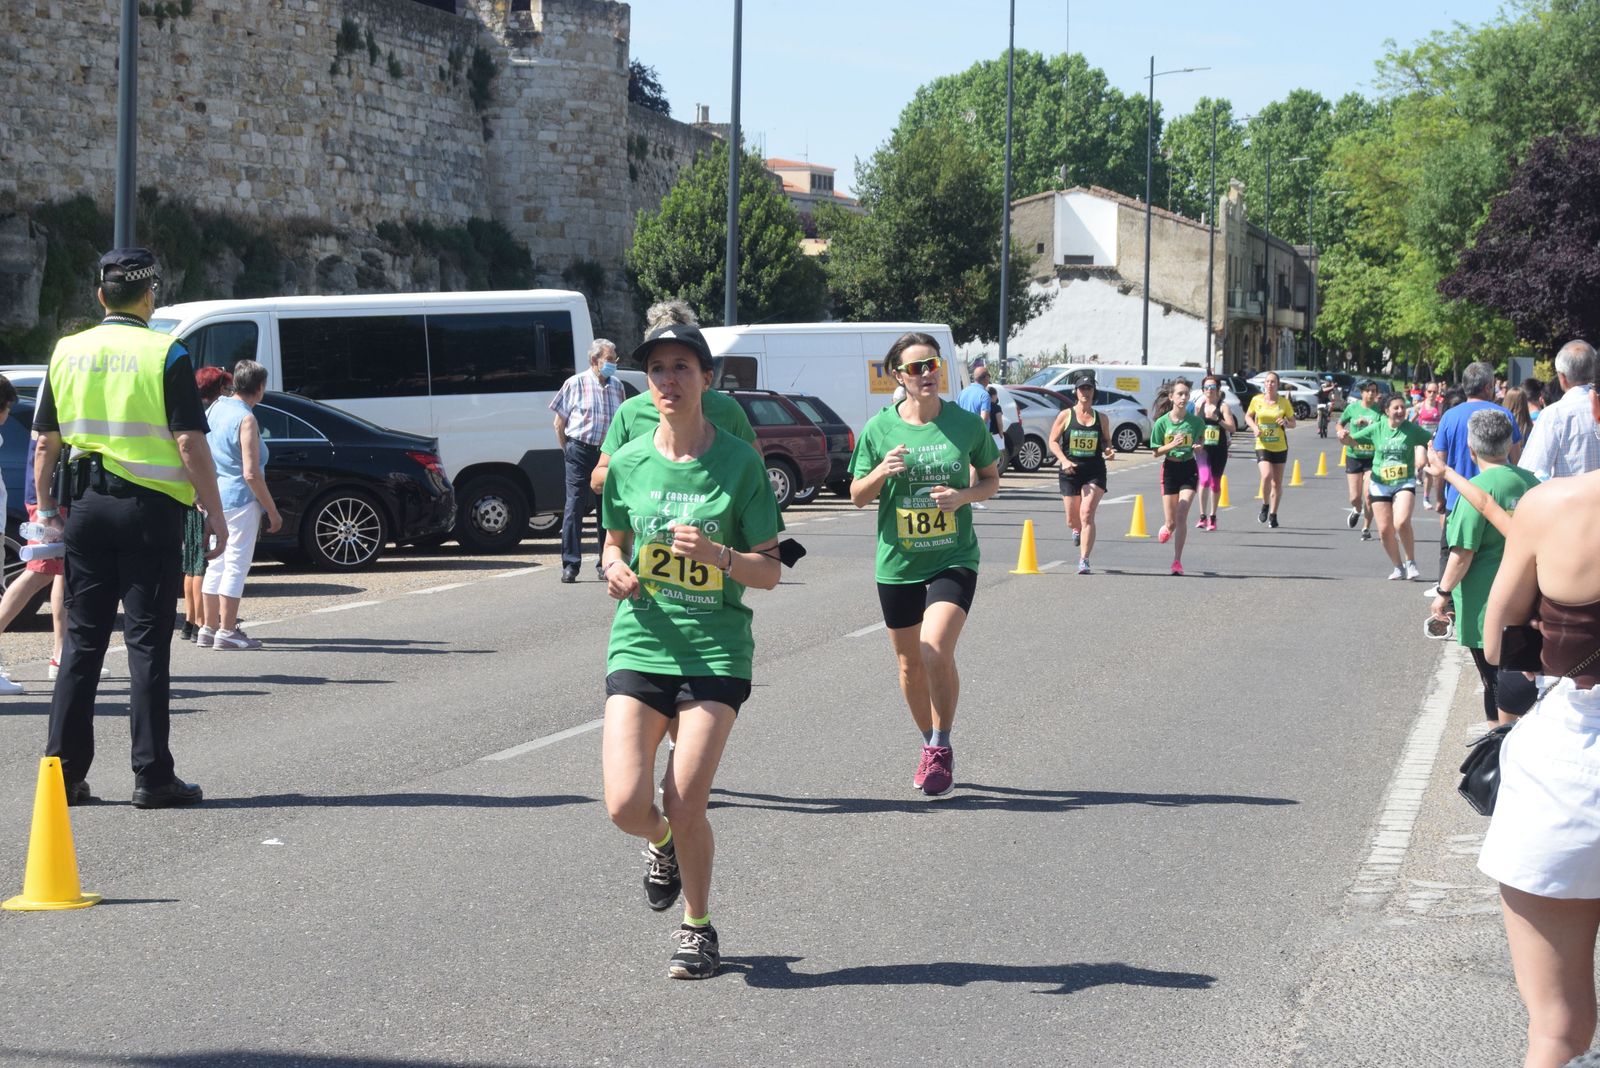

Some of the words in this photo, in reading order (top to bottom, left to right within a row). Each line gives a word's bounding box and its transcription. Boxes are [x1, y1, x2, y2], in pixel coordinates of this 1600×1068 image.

[68, 350, 139, 373] POLICÍA
[1073, 438, 1094, 450] 153
[1168, 435, 1188, 444] 21
[1384, 466, 1404, 478] 154
[903, 510, 947, 534] 184
[651, 548, 709, 586] 215
[661, 588, 684, 600] CAJA
[685, 595, 718, 604] RURAL
